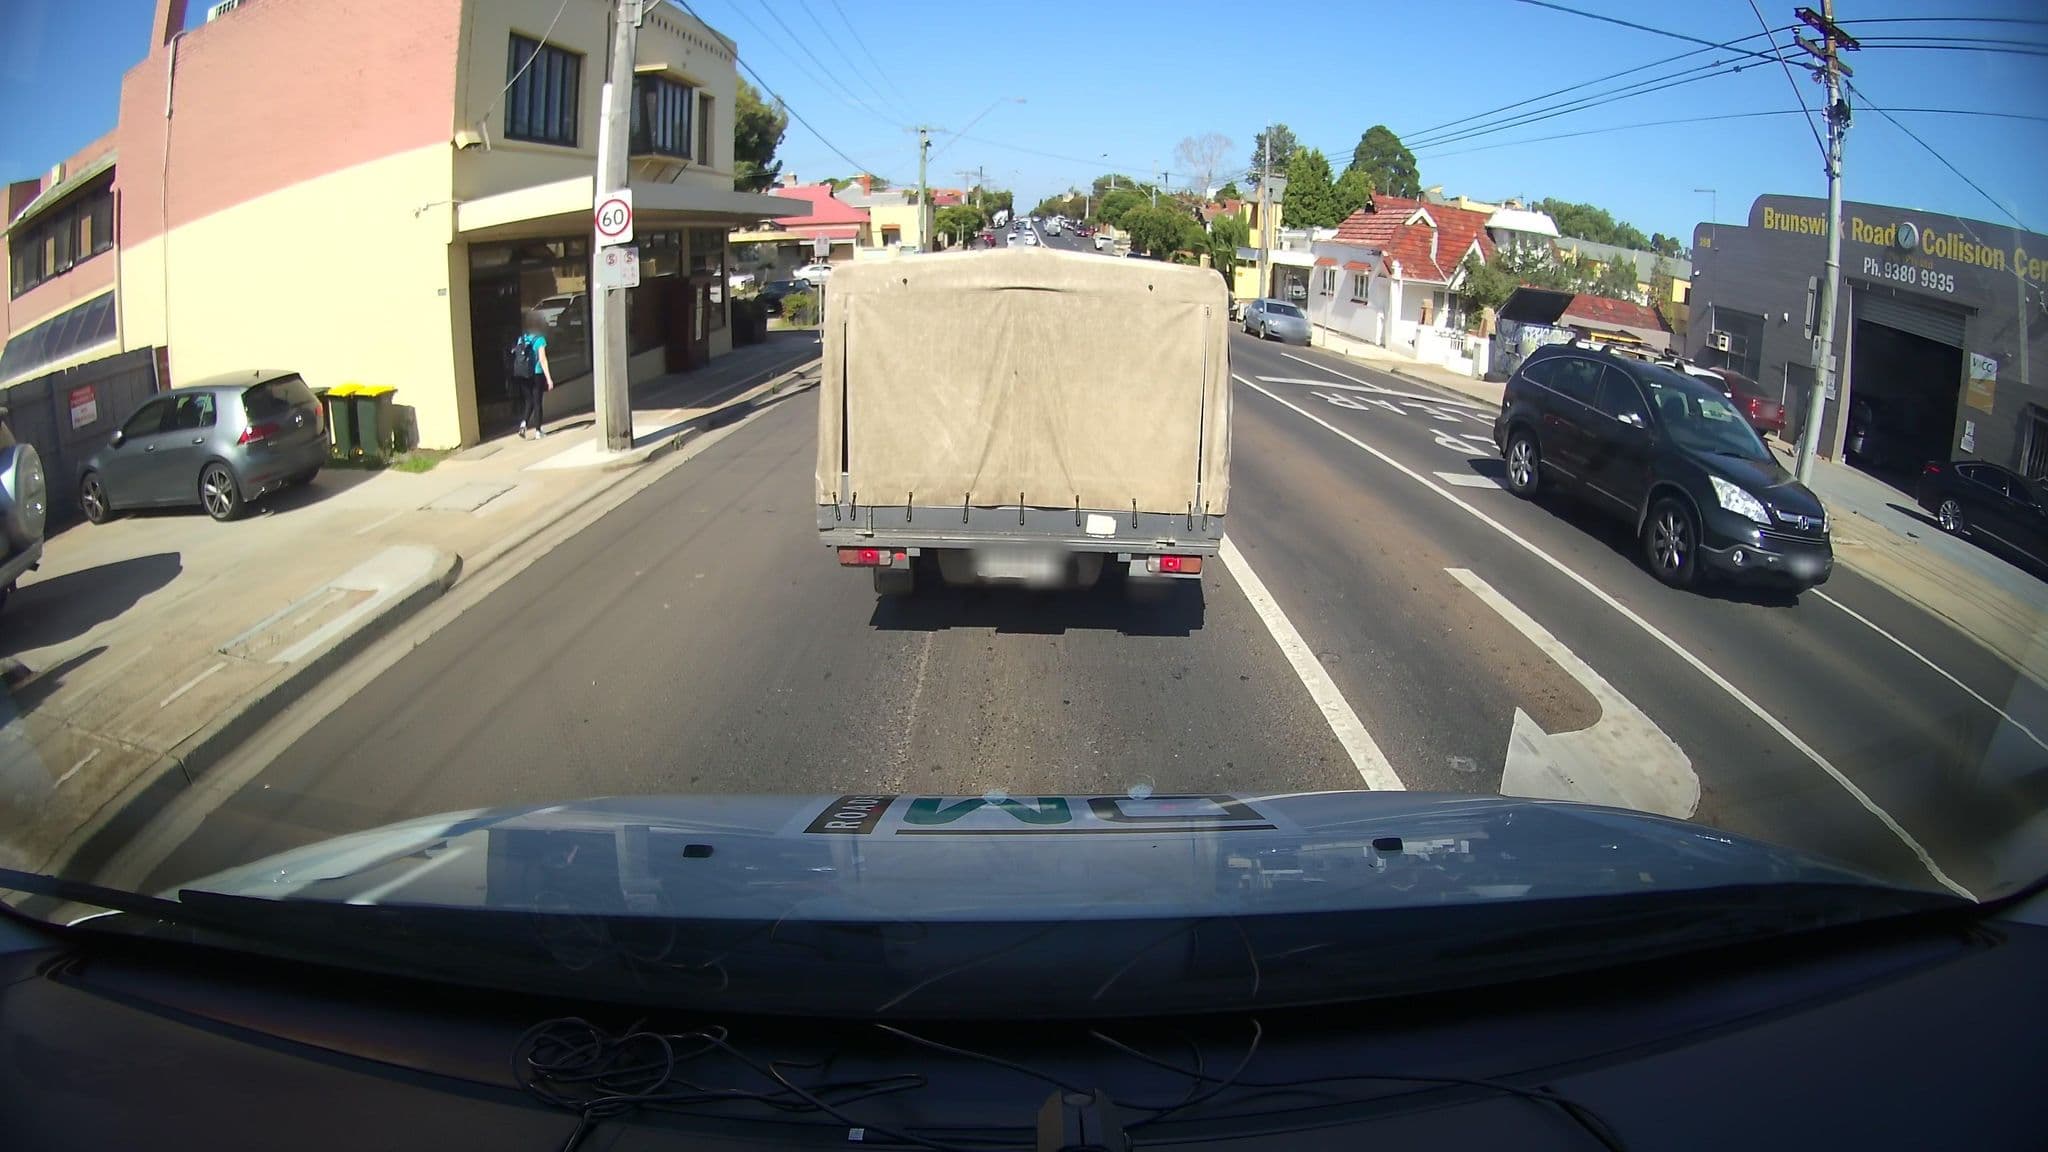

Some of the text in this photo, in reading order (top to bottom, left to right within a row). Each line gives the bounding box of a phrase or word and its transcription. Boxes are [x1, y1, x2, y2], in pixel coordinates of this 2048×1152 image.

[602, 208, 624, 228] 60
[1763, 206, 1846, 240] Brunswik
[1852, 216, 1897, 248] Road
[1922, 227, 2006, 272] Collision
[1863, 256, 1881, 278] Ph.
[1884, 262, 1916, 284] 9380
[1920, 269, 1955, 293] 9935
